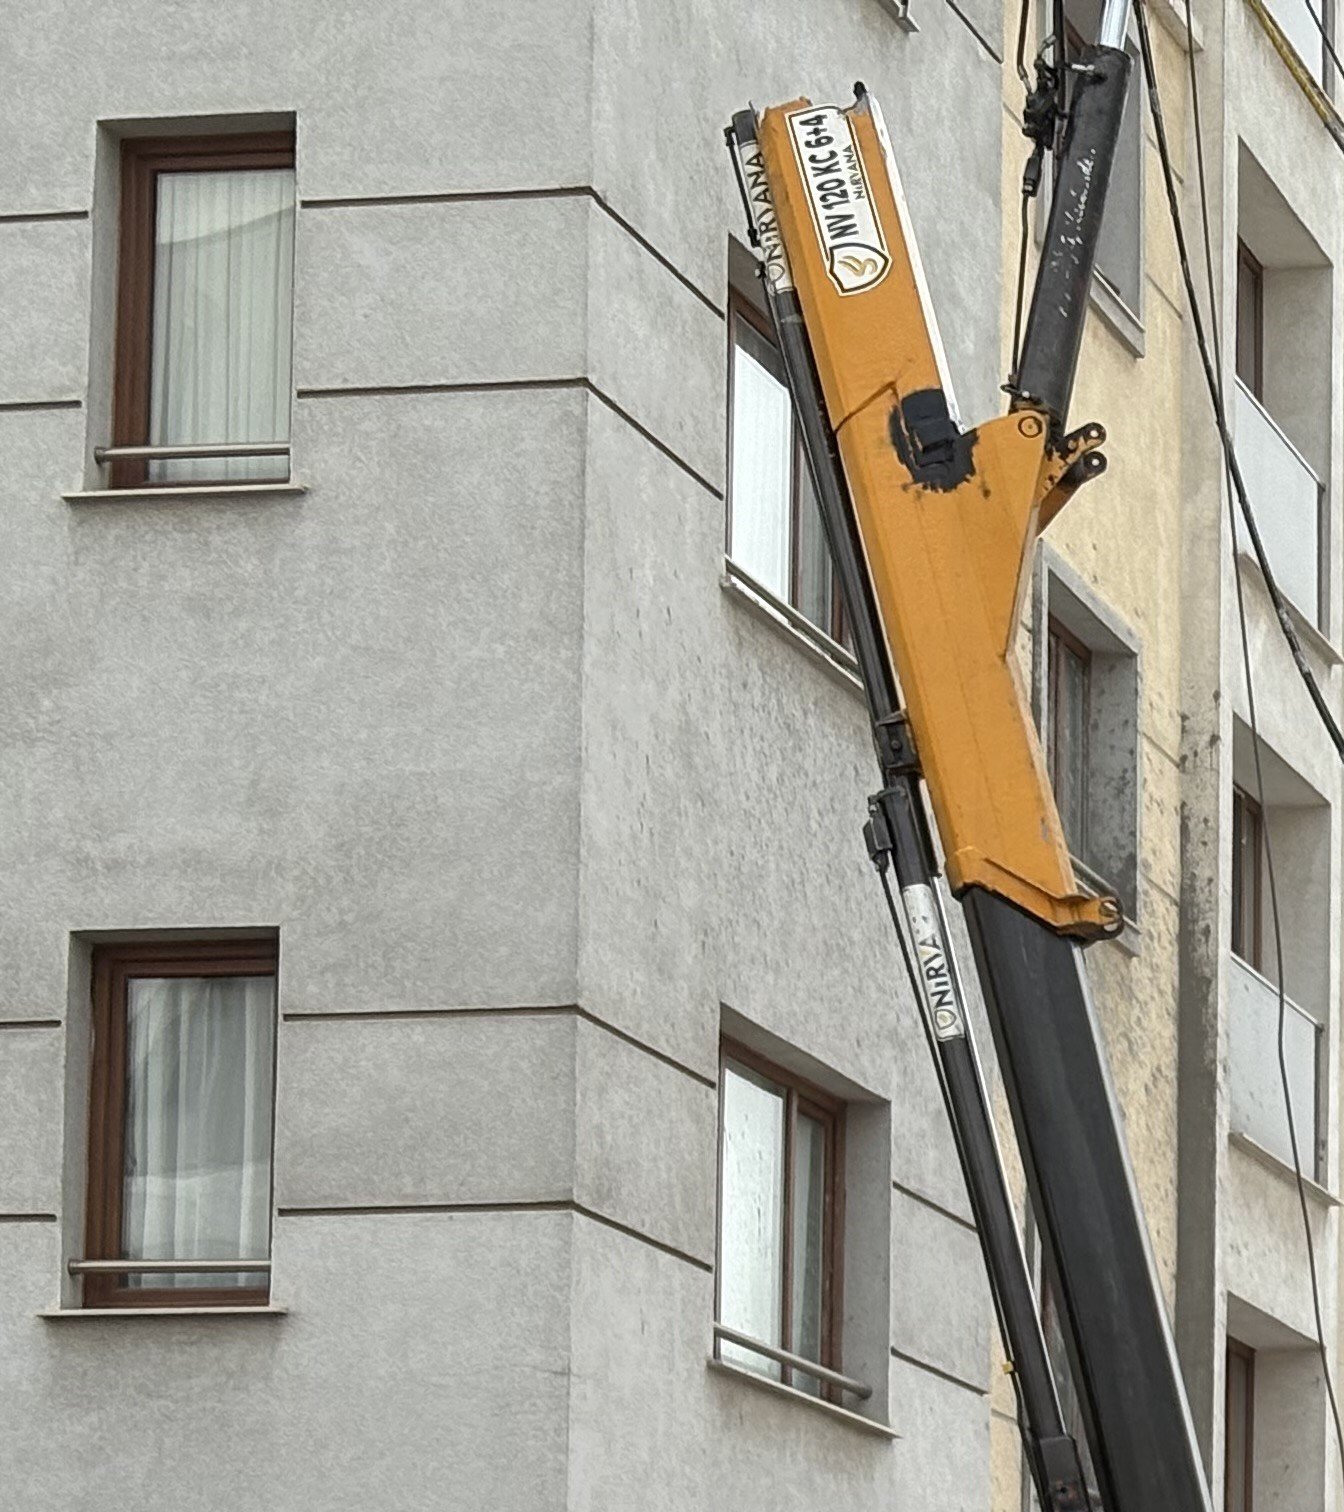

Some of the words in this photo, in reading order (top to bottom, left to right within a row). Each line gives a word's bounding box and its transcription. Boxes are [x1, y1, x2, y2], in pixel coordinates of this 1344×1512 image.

[799, 113, 834, 151] 6+4
[808, 148, 841, 178] KC
[815, 177, 850, 211] 120
[824, 213, 859, 240] NV
